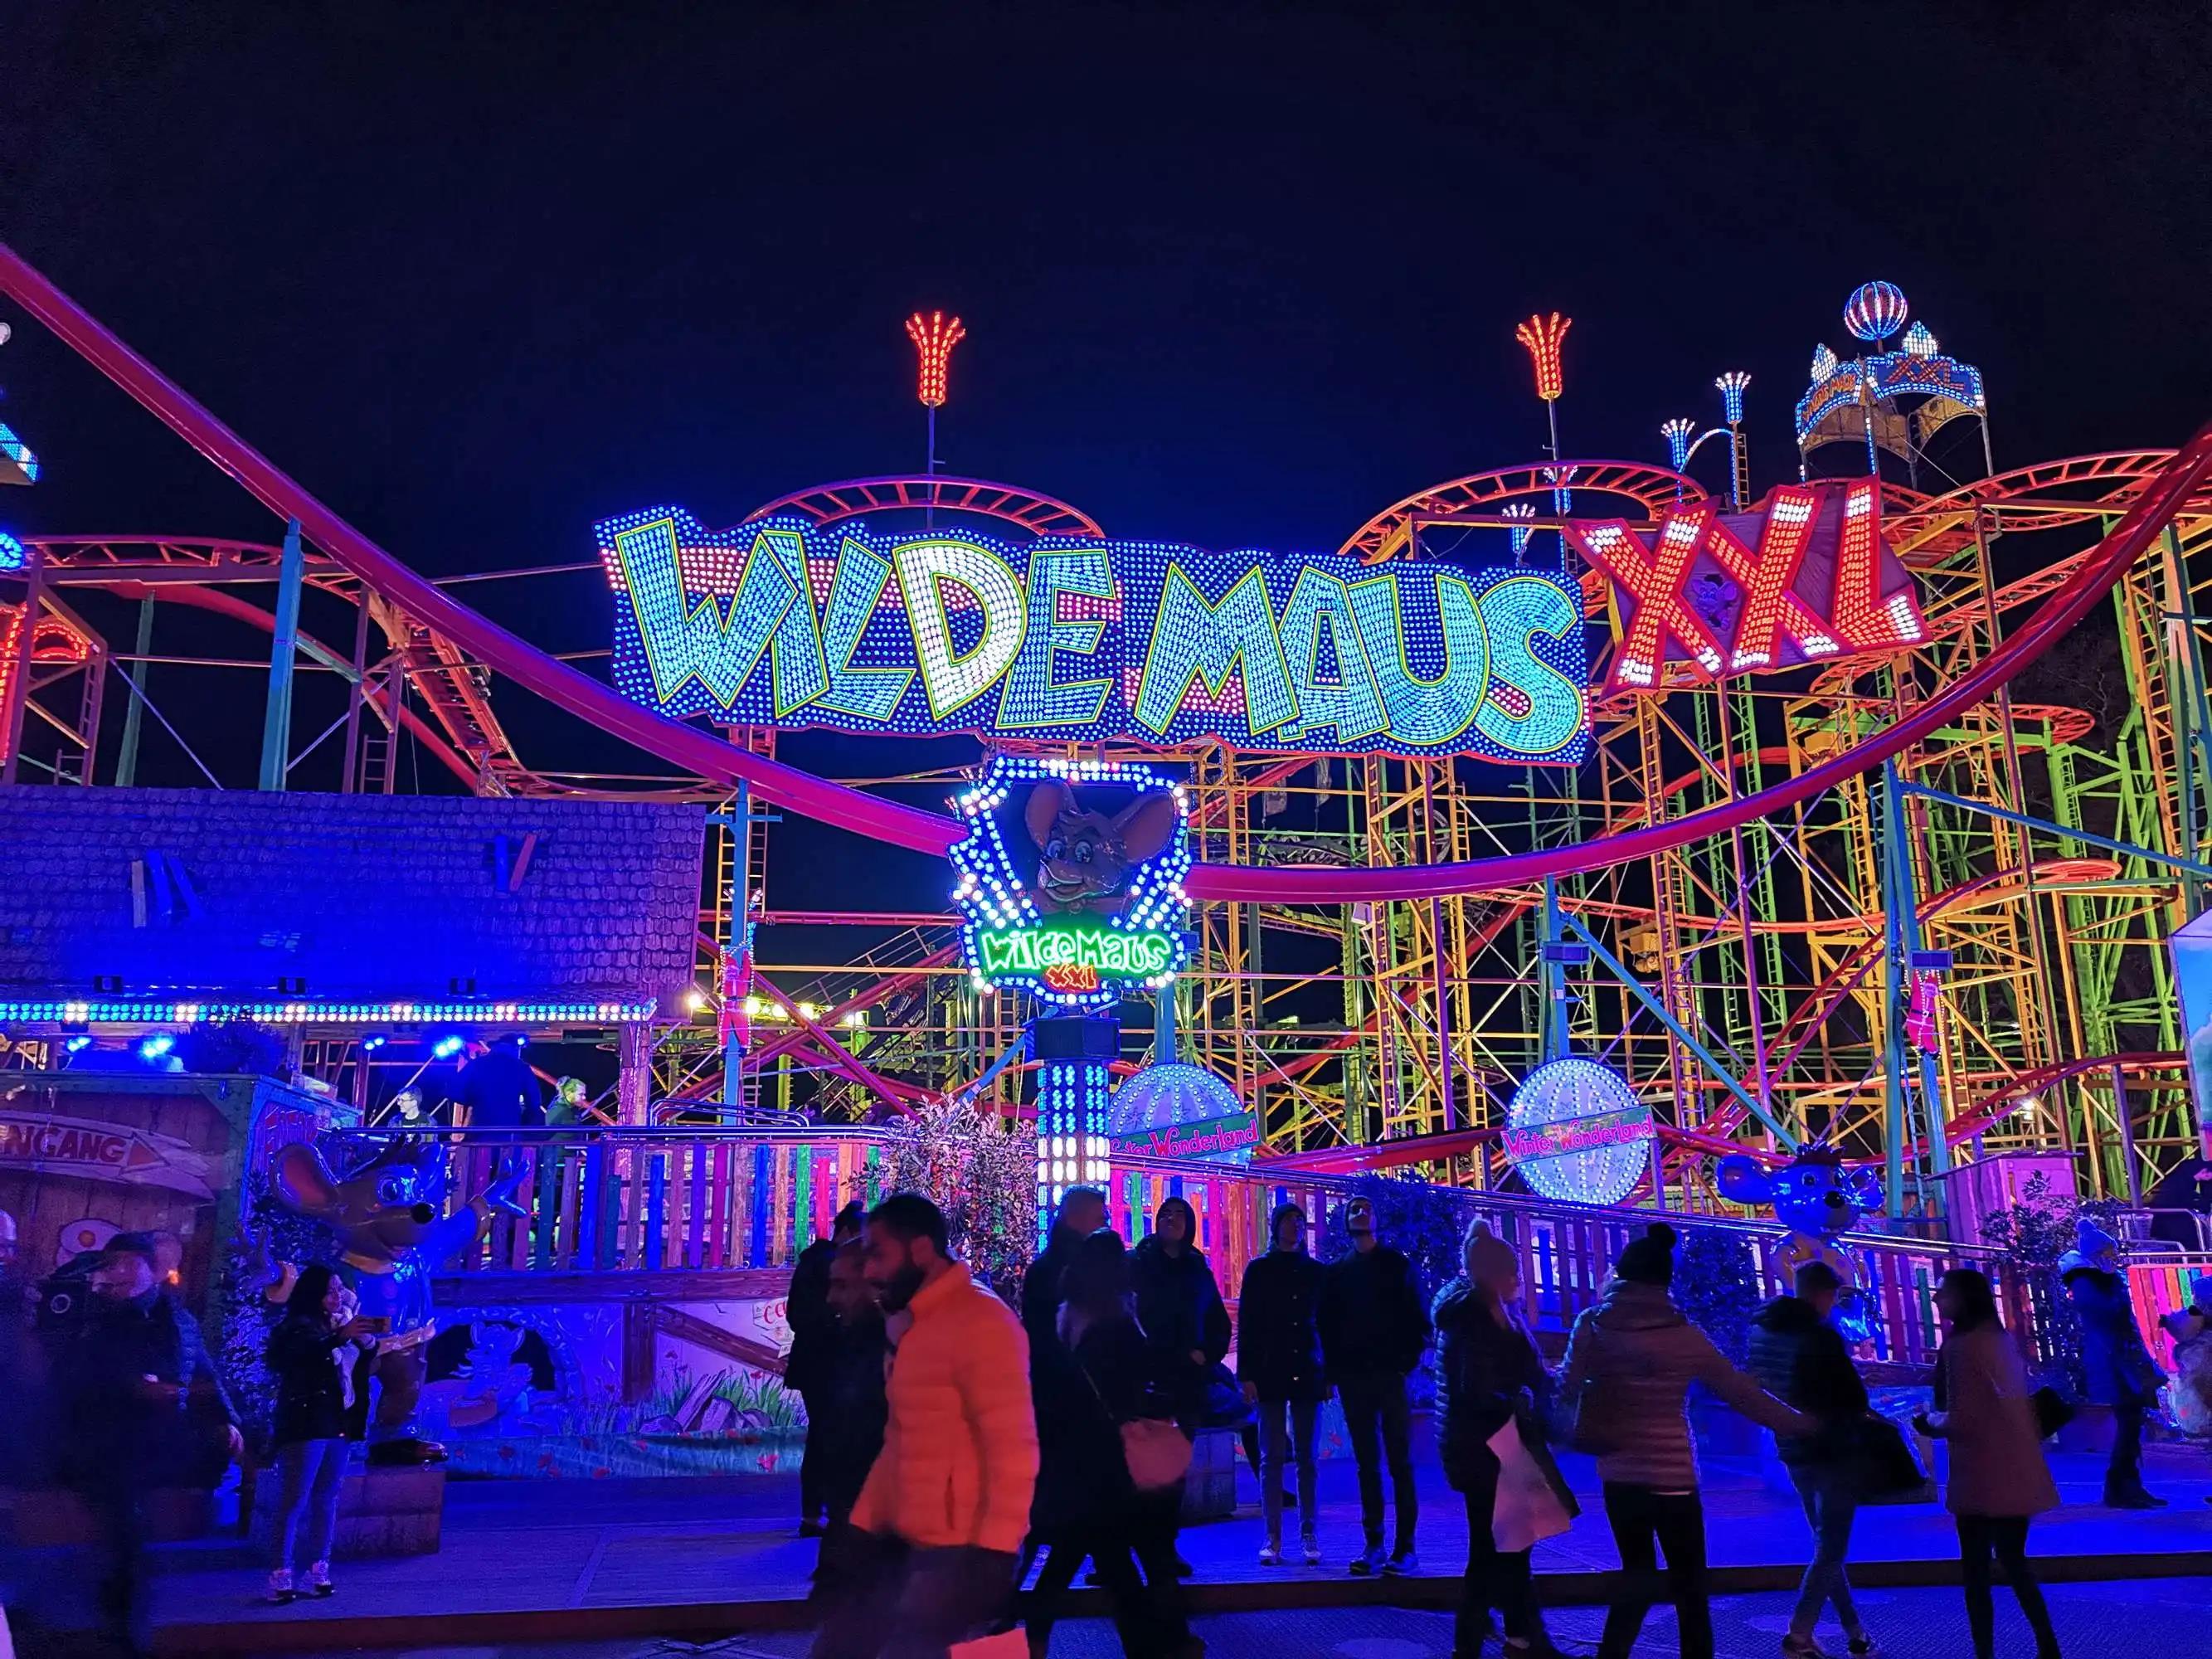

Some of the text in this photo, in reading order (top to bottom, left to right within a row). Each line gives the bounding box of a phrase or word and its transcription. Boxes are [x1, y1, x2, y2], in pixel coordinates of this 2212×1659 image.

[1885, 354, 1965, 390] XXL
[1568, 478, 1931, 695] XXL
[615, 517, 1583, 753] WILDE MAUS
[1, 1125, 126, 1162] NGANG
[1500, 1129, 1553, 1157] Winter
